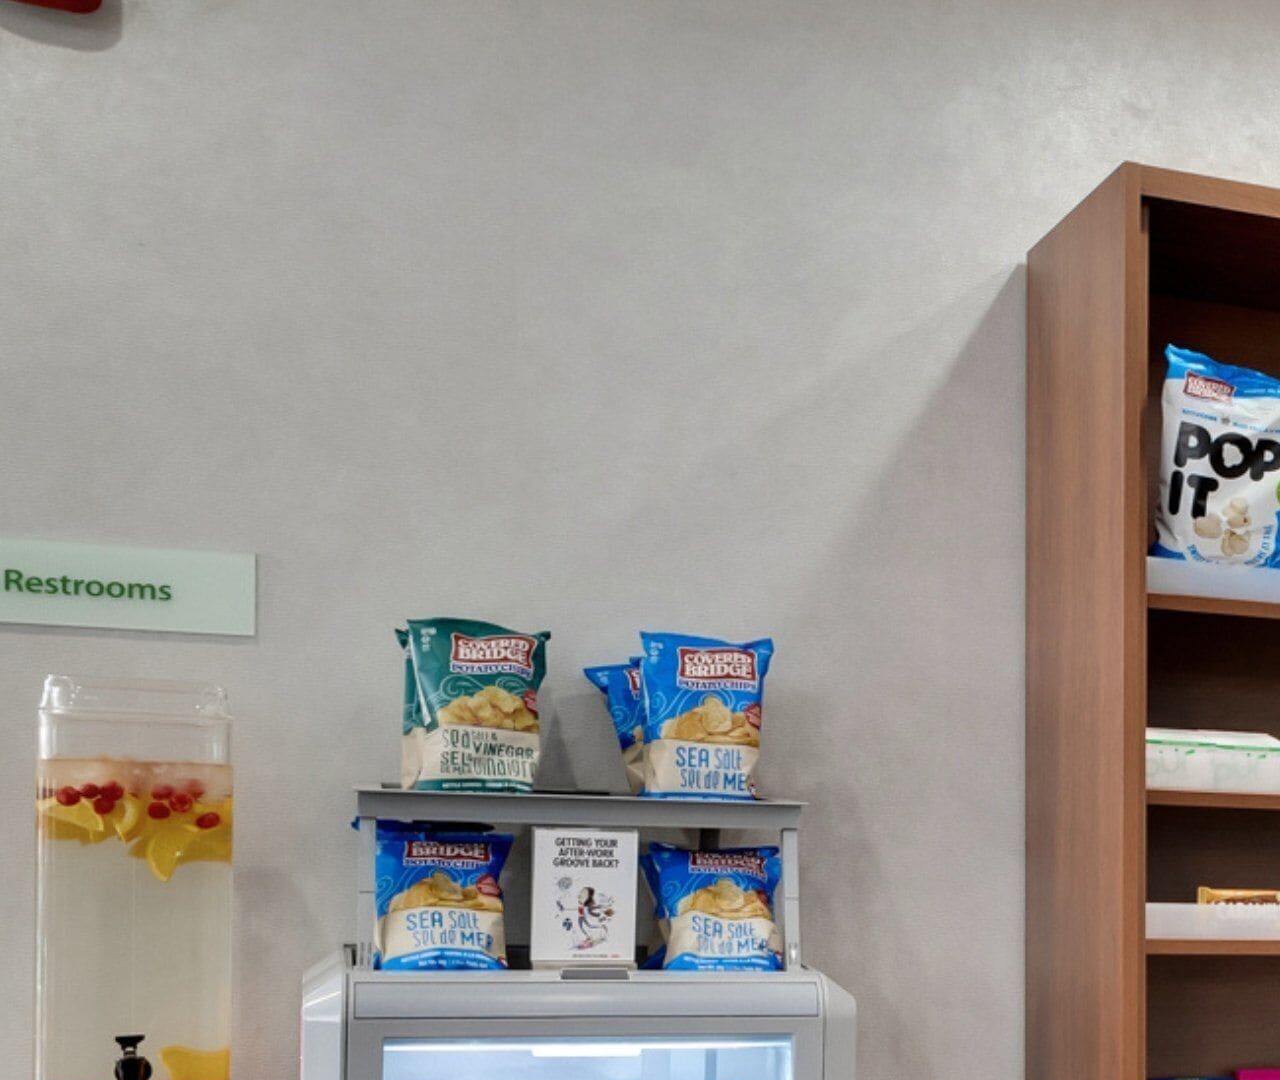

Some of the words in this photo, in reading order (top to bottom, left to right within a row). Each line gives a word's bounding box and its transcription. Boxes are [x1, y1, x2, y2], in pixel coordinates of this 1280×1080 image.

[1168, 470, 1219, 519] IT
[4, 568, 172, 601] Restrooms
[457, 638, 530, 652] COVERED
[458, 648, 530, 664] BRIDGE
[684, 652, 752, 665] COVERED
[684, 664, 753, 678] BRIDGE
[472, 741, 535, 761] VINEGAR
[676, 747, 710, 768] SEA
[411, 841, 487, 857] BRIDGE
[554, 838, 592, 848] GETTING
[594, 839, 618, 848] YOUR
[558, 847, 614, 858] AFTER-WORK
[552, 857, 590, 868] GROOVE
[592, 858, 620, 868] BACK?
[406, 910, 443, 931] SEA
[692, 916, 723, 937] SEA
